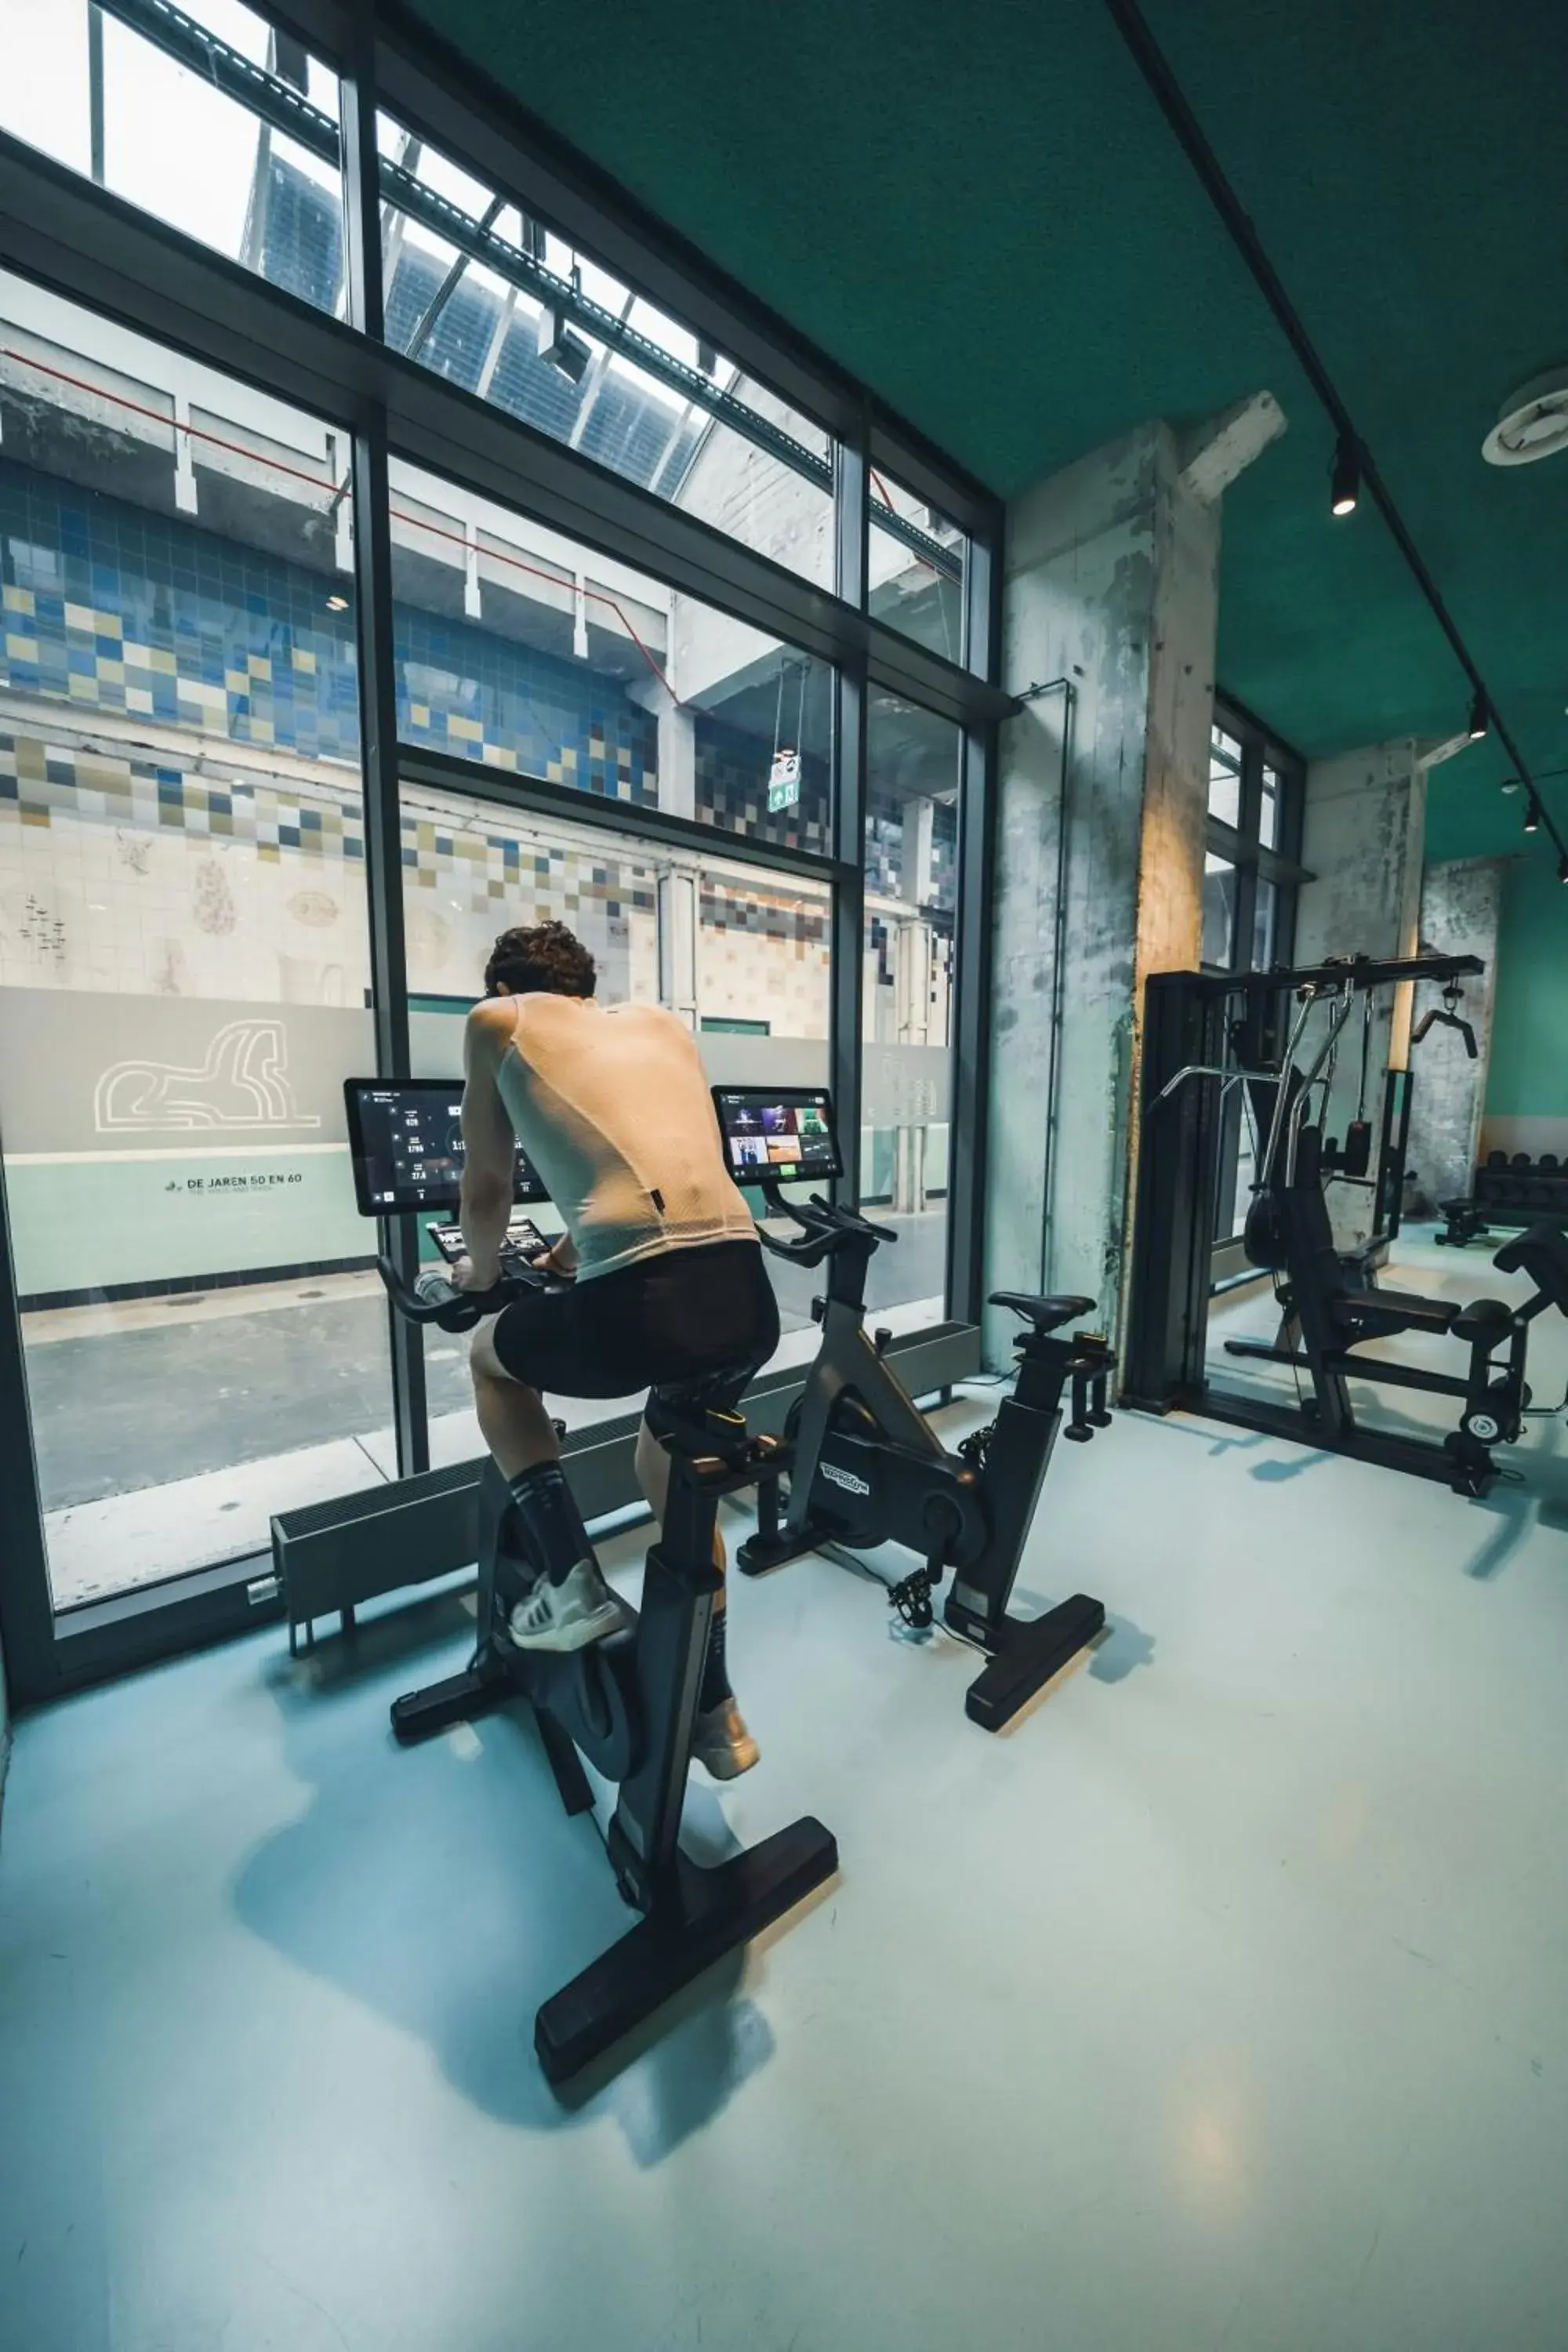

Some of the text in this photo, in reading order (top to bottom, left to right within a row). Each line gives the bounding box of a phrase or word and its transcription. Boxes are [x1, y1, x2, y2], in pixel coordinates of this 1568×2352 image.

[187, 1174, 303, 1189] DE JAREN 50 EN 60
